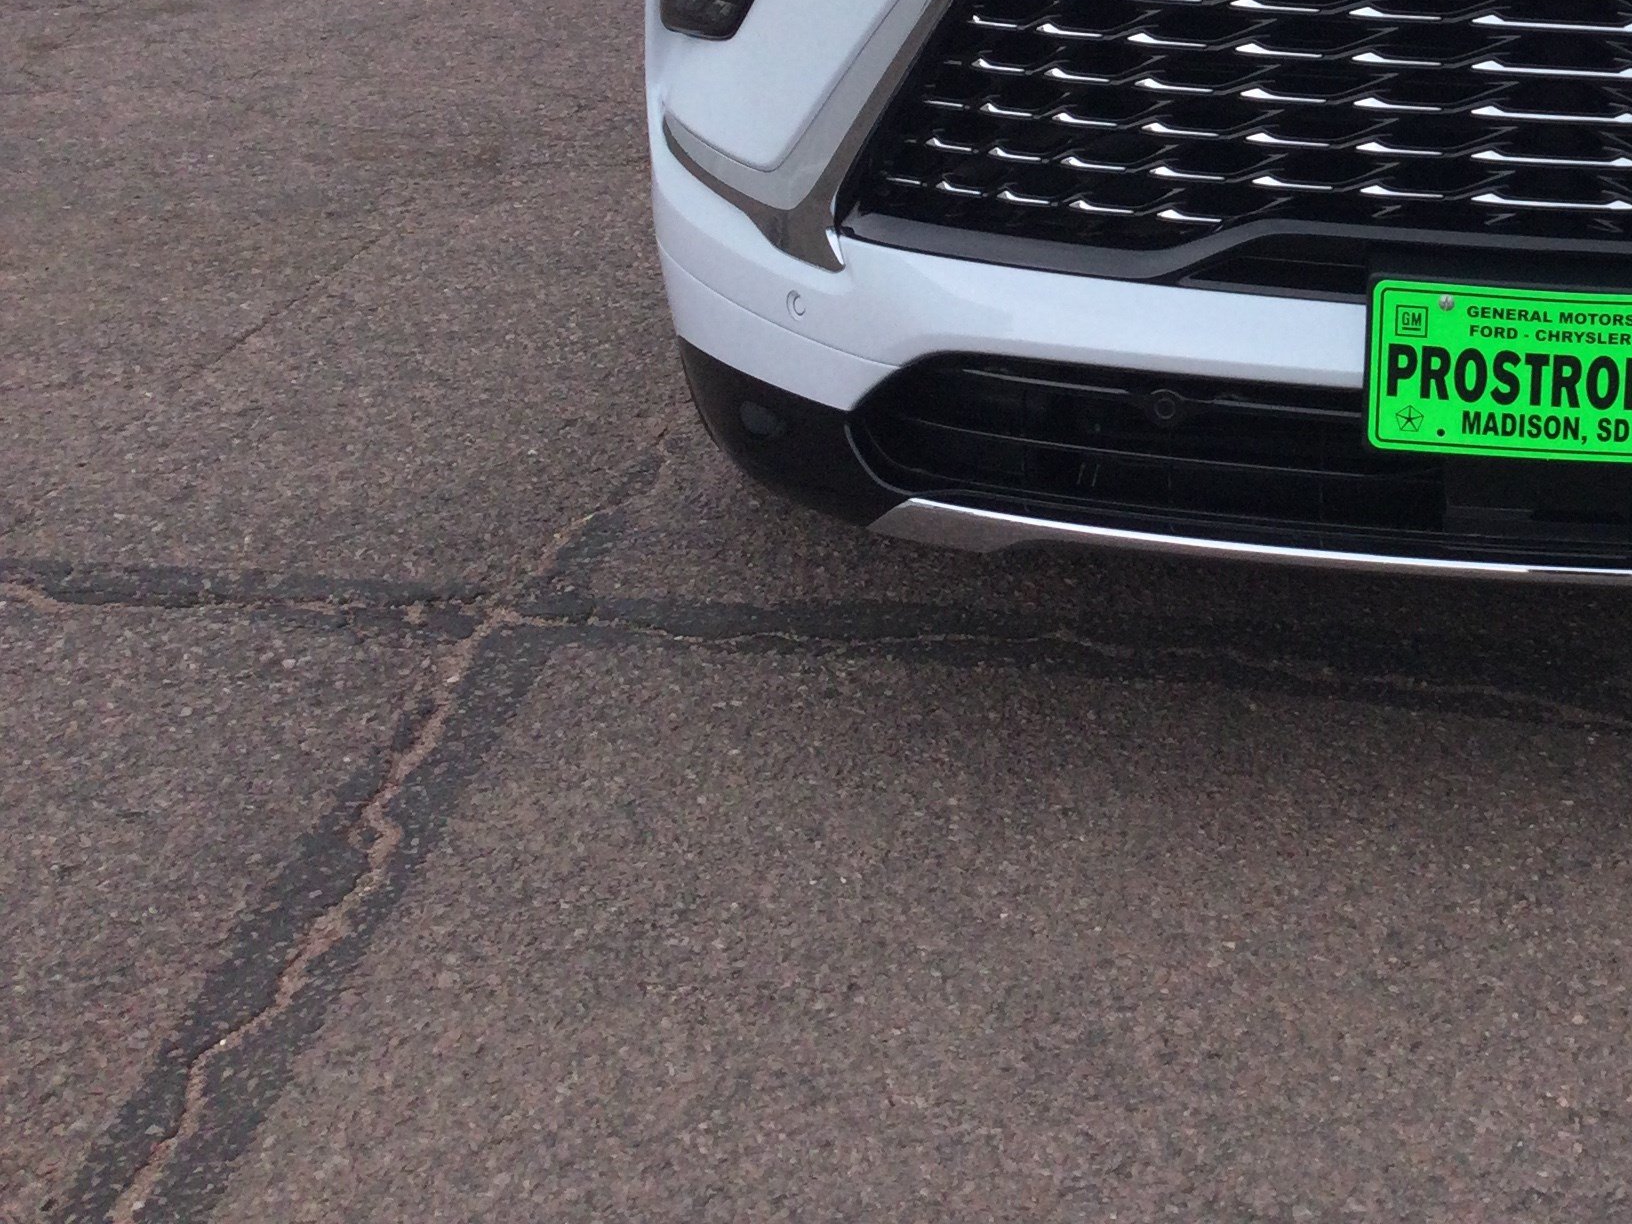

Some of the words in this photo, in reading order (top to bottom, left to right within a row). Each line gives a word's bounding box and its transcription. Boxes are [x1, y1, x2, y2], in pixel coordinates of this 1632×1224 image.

[1402, 311, 1422, 327] GM
[1466, 305, 1553, 323] GENERAL
[1469, 324, 1518, 339] FORD
[1535, 329, 1632, 345] CHRYSLER
[1461, 410, 1588, 445] MADISON,
[1596, 417, 1630, 442] SD
